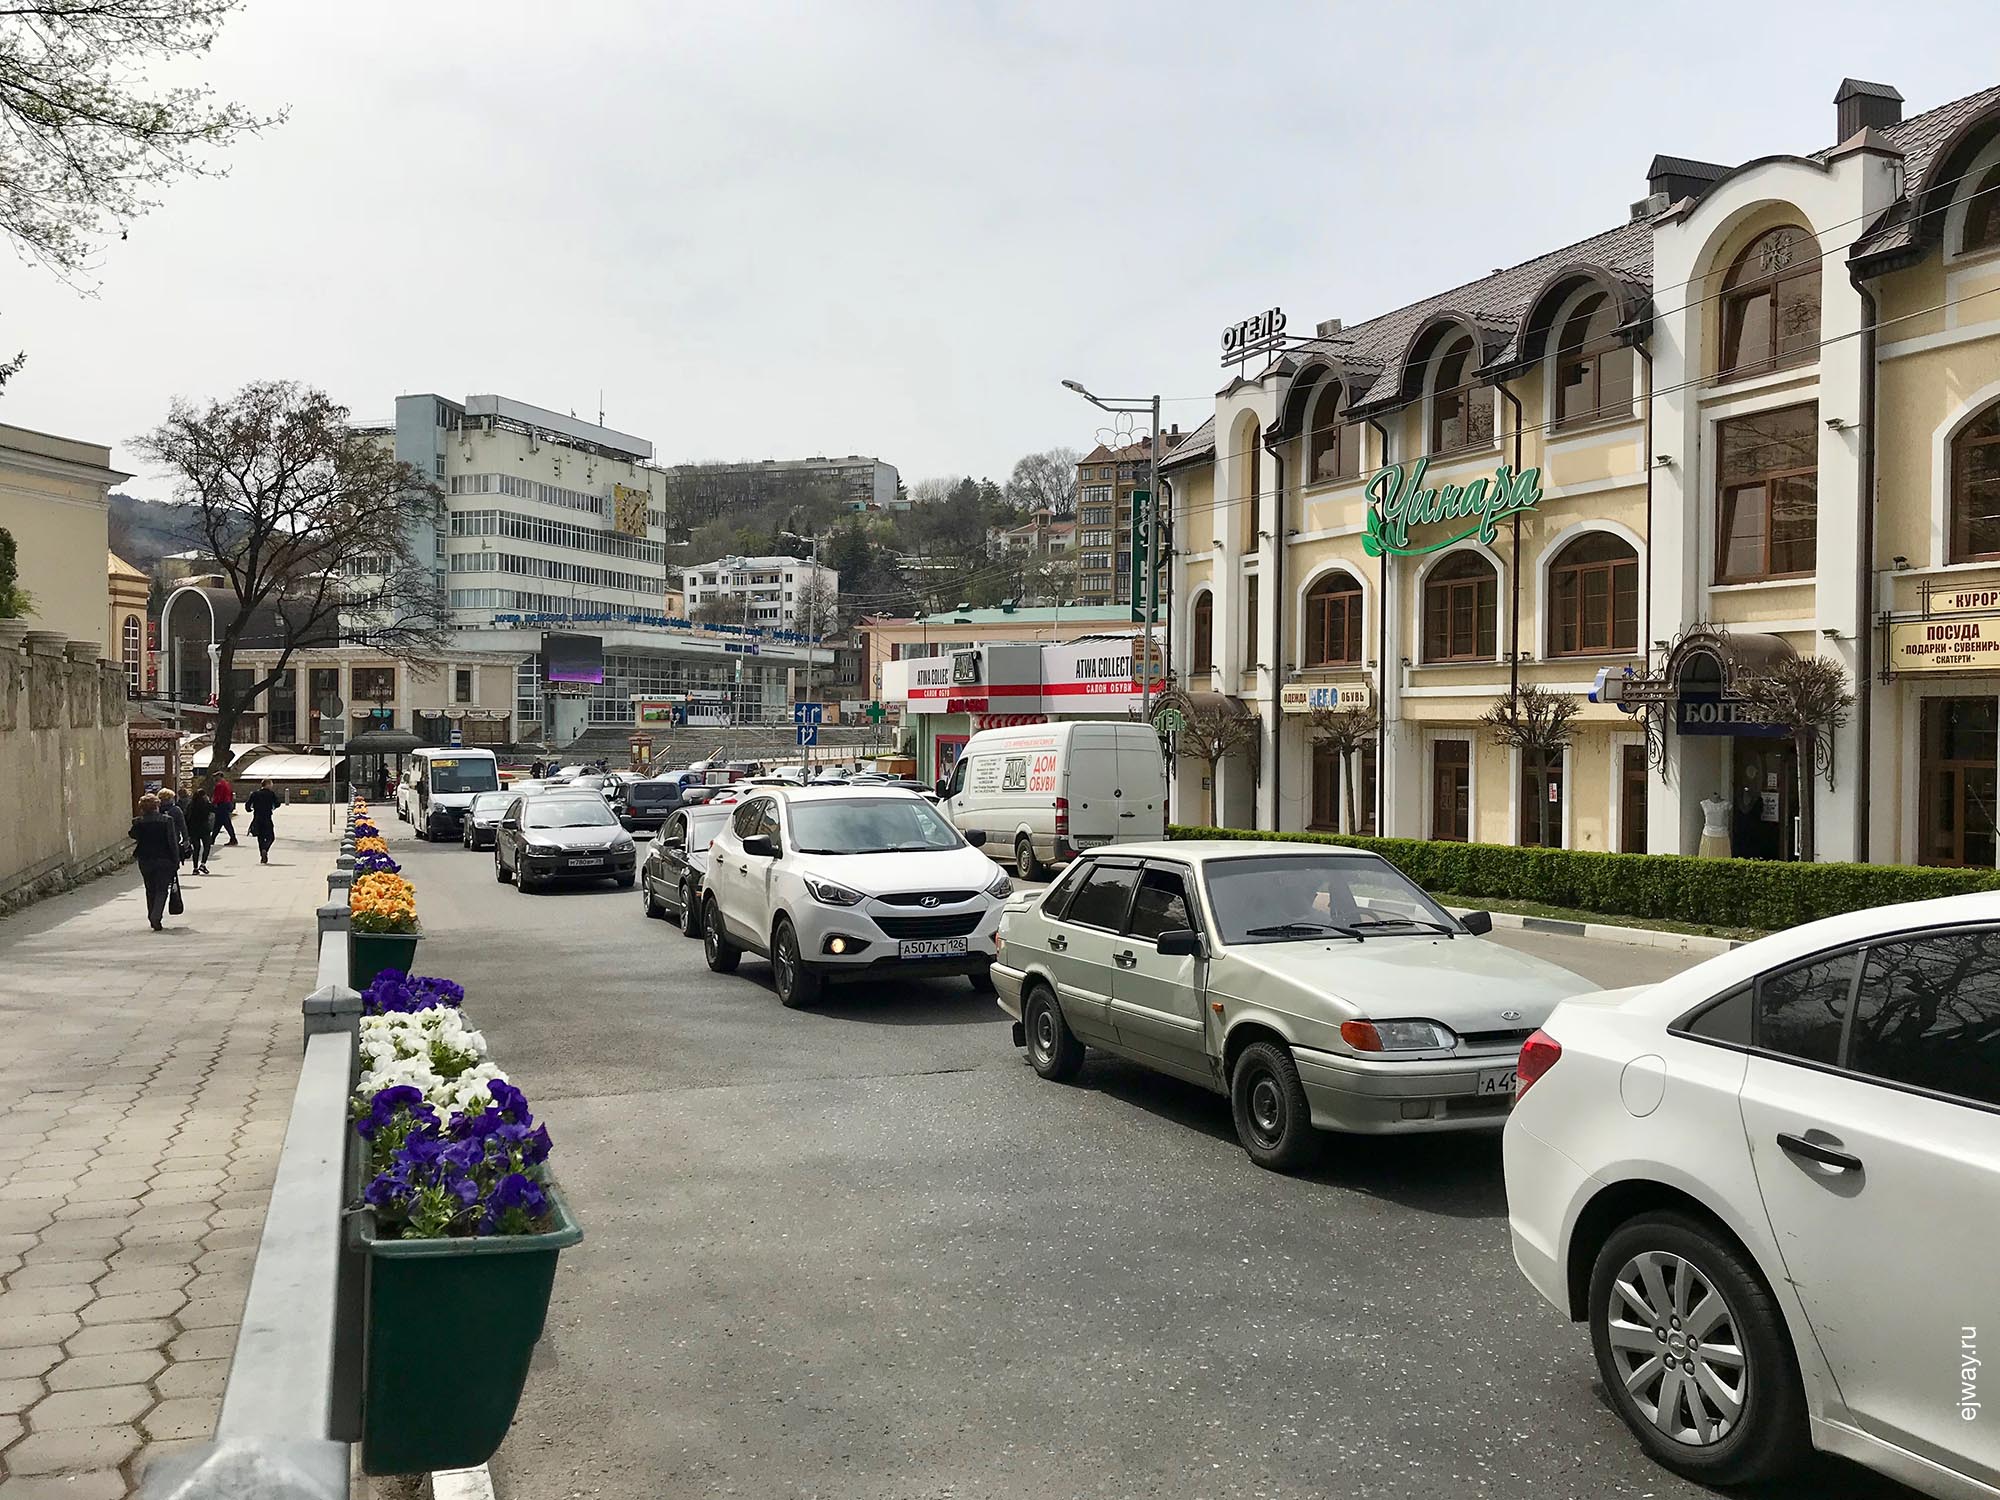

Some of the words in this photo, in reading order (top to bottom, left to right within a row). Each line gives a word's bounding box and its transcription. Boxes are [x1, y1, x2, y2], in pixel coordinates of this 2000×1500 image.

[1221, 306, 1287, 351] ОТЕЛЬ
[1365, 457, 1543, 547] Чинара
[1956, 591, 2000, 608] КУРОР
[1927, 623, 1980, 641] ПОСУДА
[1905, 643, 1947, 656] ПОДАРКИ
[1936, 655, 1971, 664] СКАТЕРТИ
[931, 668, 949, 685] COLLEC
[1076, 658, 1097, 679] ATWA
[1086, 684, 1107, 693] САЛОН
[1110, 683, 1132, 693] ОБУВИ
[1284, 692, 1307, 704] ОДЕЖДА
[1341, 691, 1365, 703] ОБУВЬ
[1153, 708, 1187, 731] ОТЕЛЬ
[1033, 755, 1057, 774] ДОМ
[1029, 776, 1056, 792] ОБУВИ
[904, 941, 946, 955] А507КТ
[948, 939, 964, 949] 126
